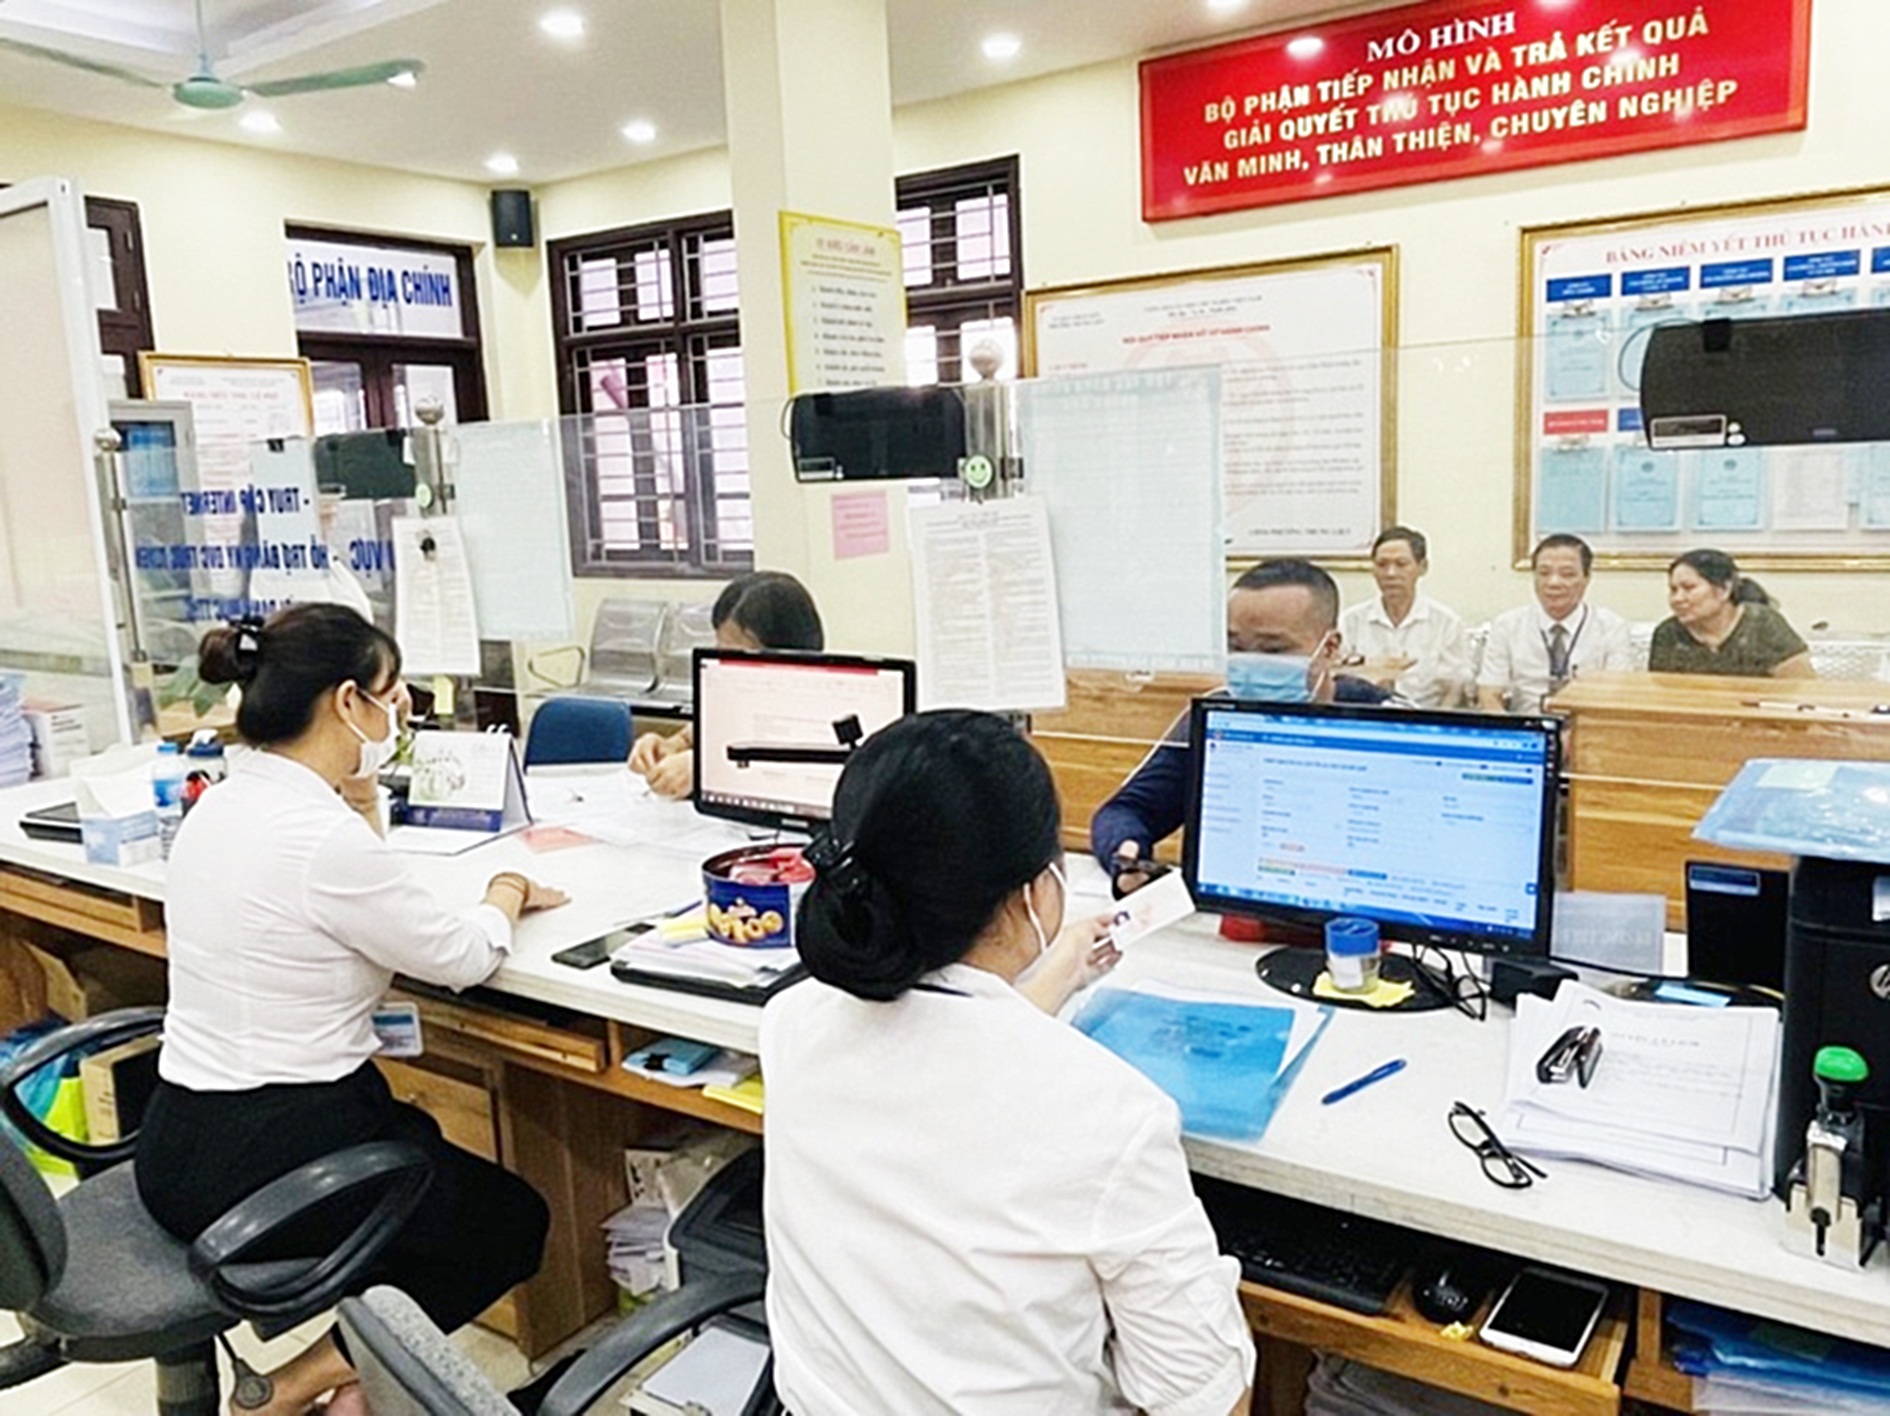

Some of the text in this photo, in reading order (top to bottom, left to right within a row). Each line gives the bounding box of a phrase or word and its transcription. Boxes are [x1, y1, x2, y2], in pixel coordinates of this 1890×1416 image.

[1204, 5, 1709, 123] BỘ PHẬN TIẾP NHẬN VÀ TRẢ KẾT QUẢ
[1366, 12, 1516, 62] MÔ HÌNH
[1183, 78, 1739, 185] VĂN MINH, THÂN THIỆN, CHUYÊN NGHIỆP
[1224, 119, 1271, 149] GIẢI
[1279, 103, 1359, 140] QUYẾT
[1366, 92, 1419, 126] THỦ
[1428, 87, 1481, 117] TỤC
[1491, 71, 1571, 105] HÀNH
[311, 257, 362, 306] PHẬN
[367, 265, 398, 309] ĐỊA
[401, 264, 452, 307] CHÍNH
